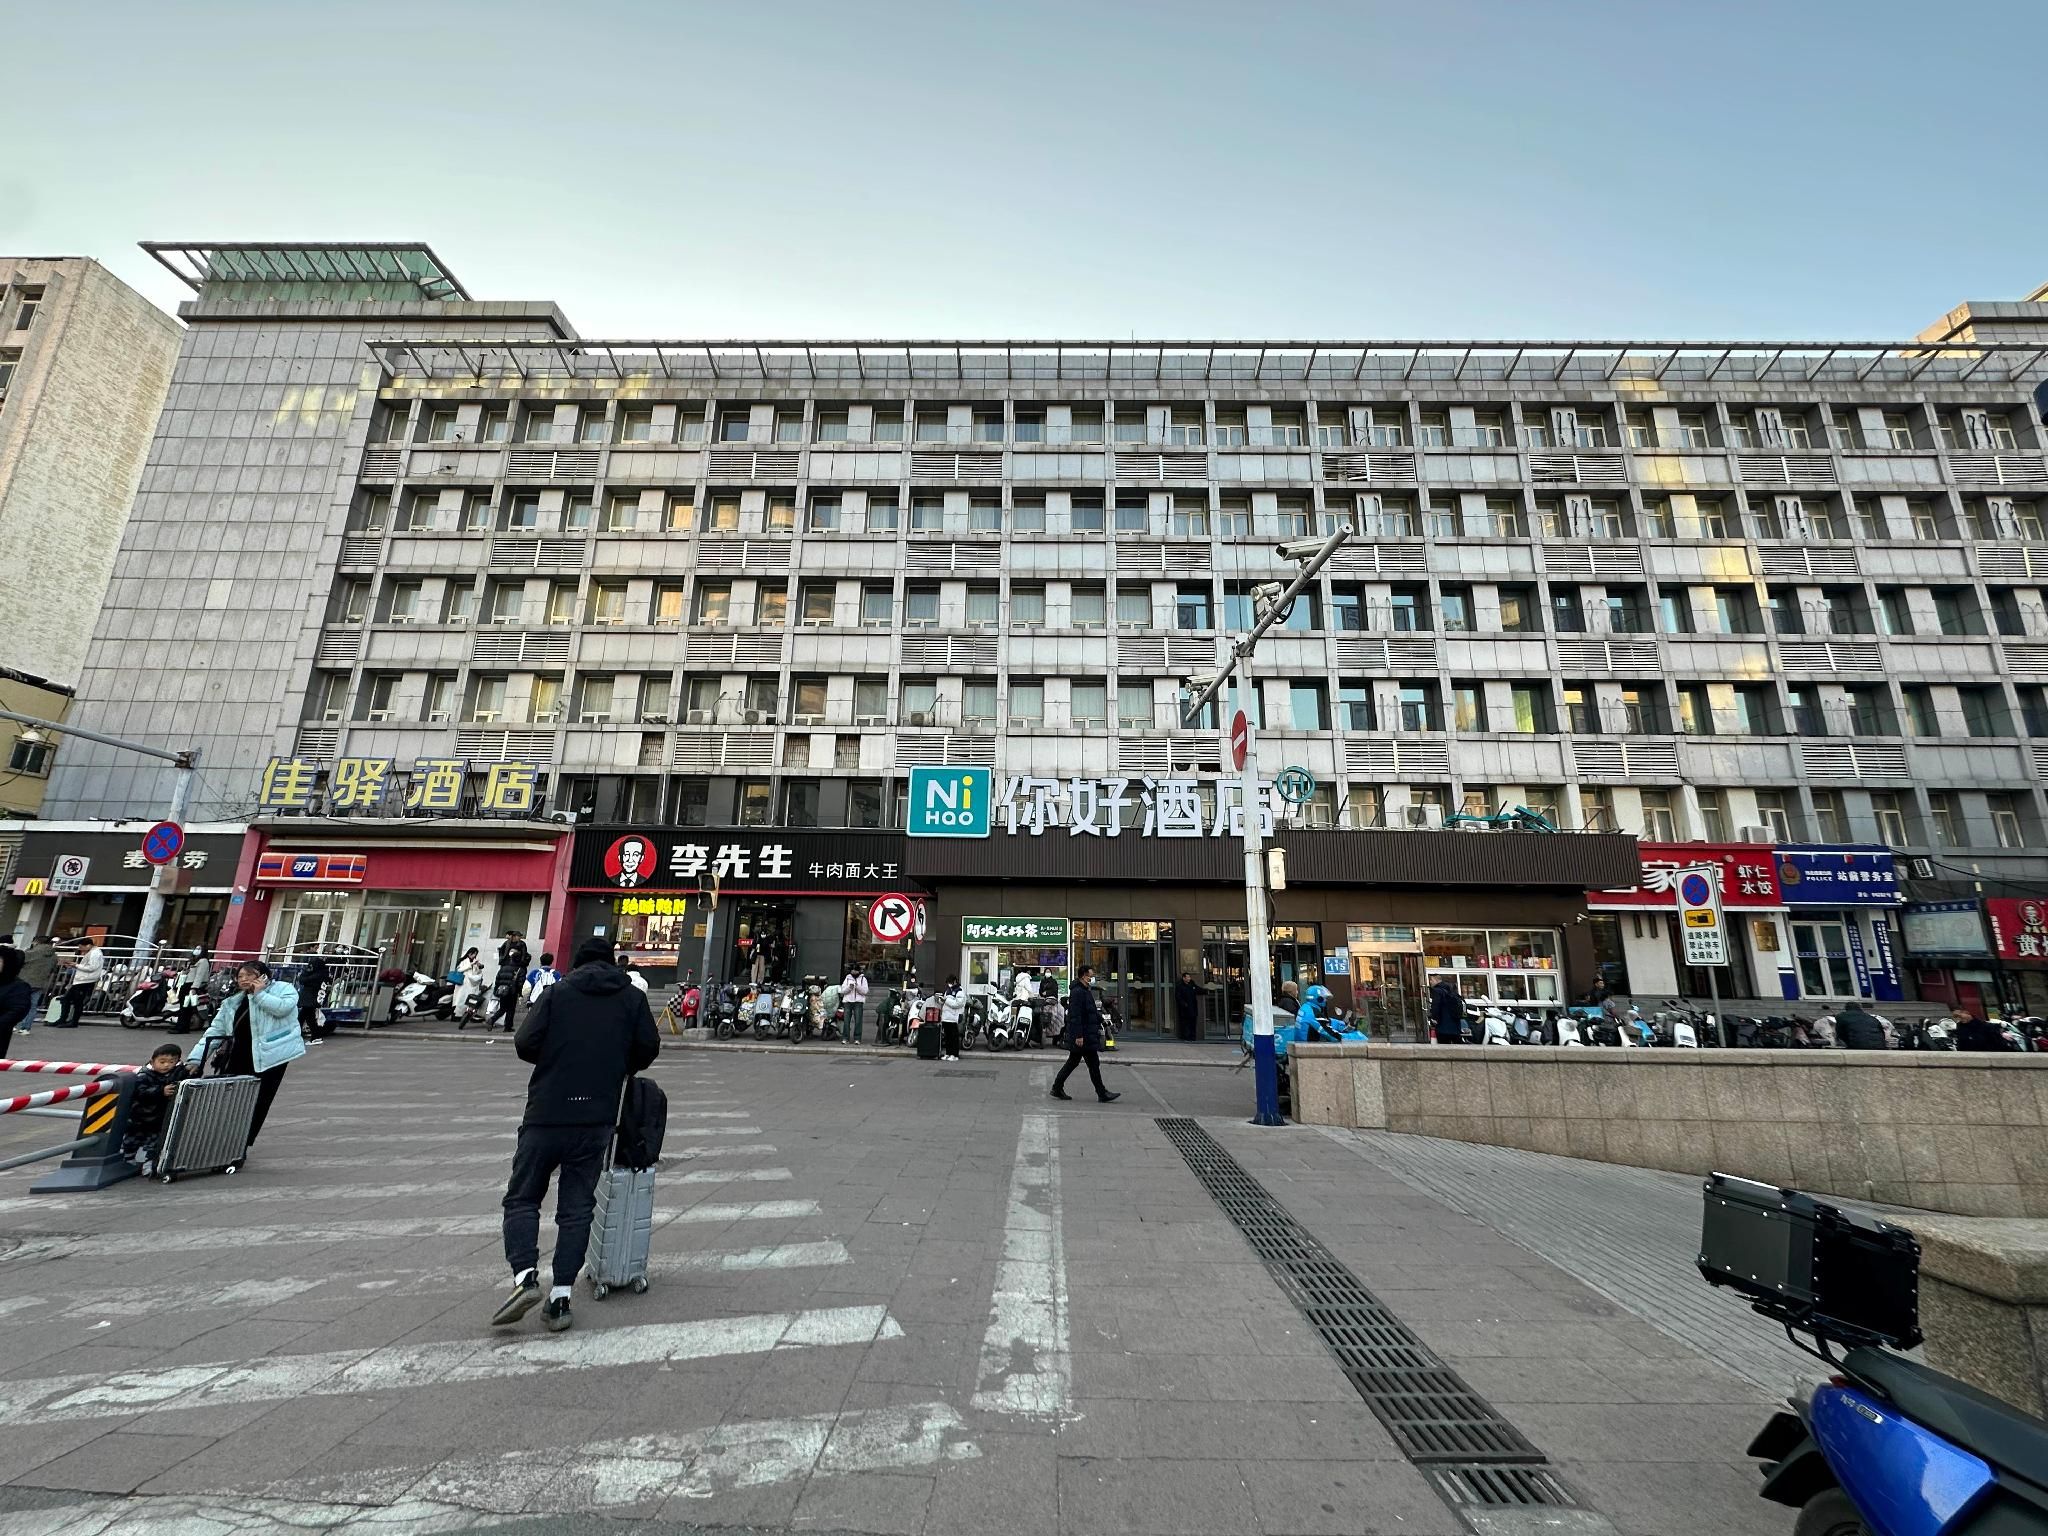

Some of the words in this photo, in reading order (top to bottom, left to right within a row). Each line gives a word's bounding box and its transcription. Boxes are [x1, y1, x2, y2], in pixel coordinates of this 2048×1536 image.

[258, 756, 537, 810] 佳驿酒店
[926, 776, 973, 810] Ni
[1000, 774, 1275, 838] 你好酒店
[122, 850, 209, 869] 麦劳
[293, 861, 316, 873] 可好
[669, 844, 793, 879] 李先生
[808, 862, 898, 880] 牛肉面大王
[1738, 864, 1770, 878] 虾仁
[1741, 881, 1773, 895] 水饺
[1689, 941, 1719, 950] 禁止停车
[2017, 934, 2048, 957] 黄
[1328, 963, 1346, 971] 115
